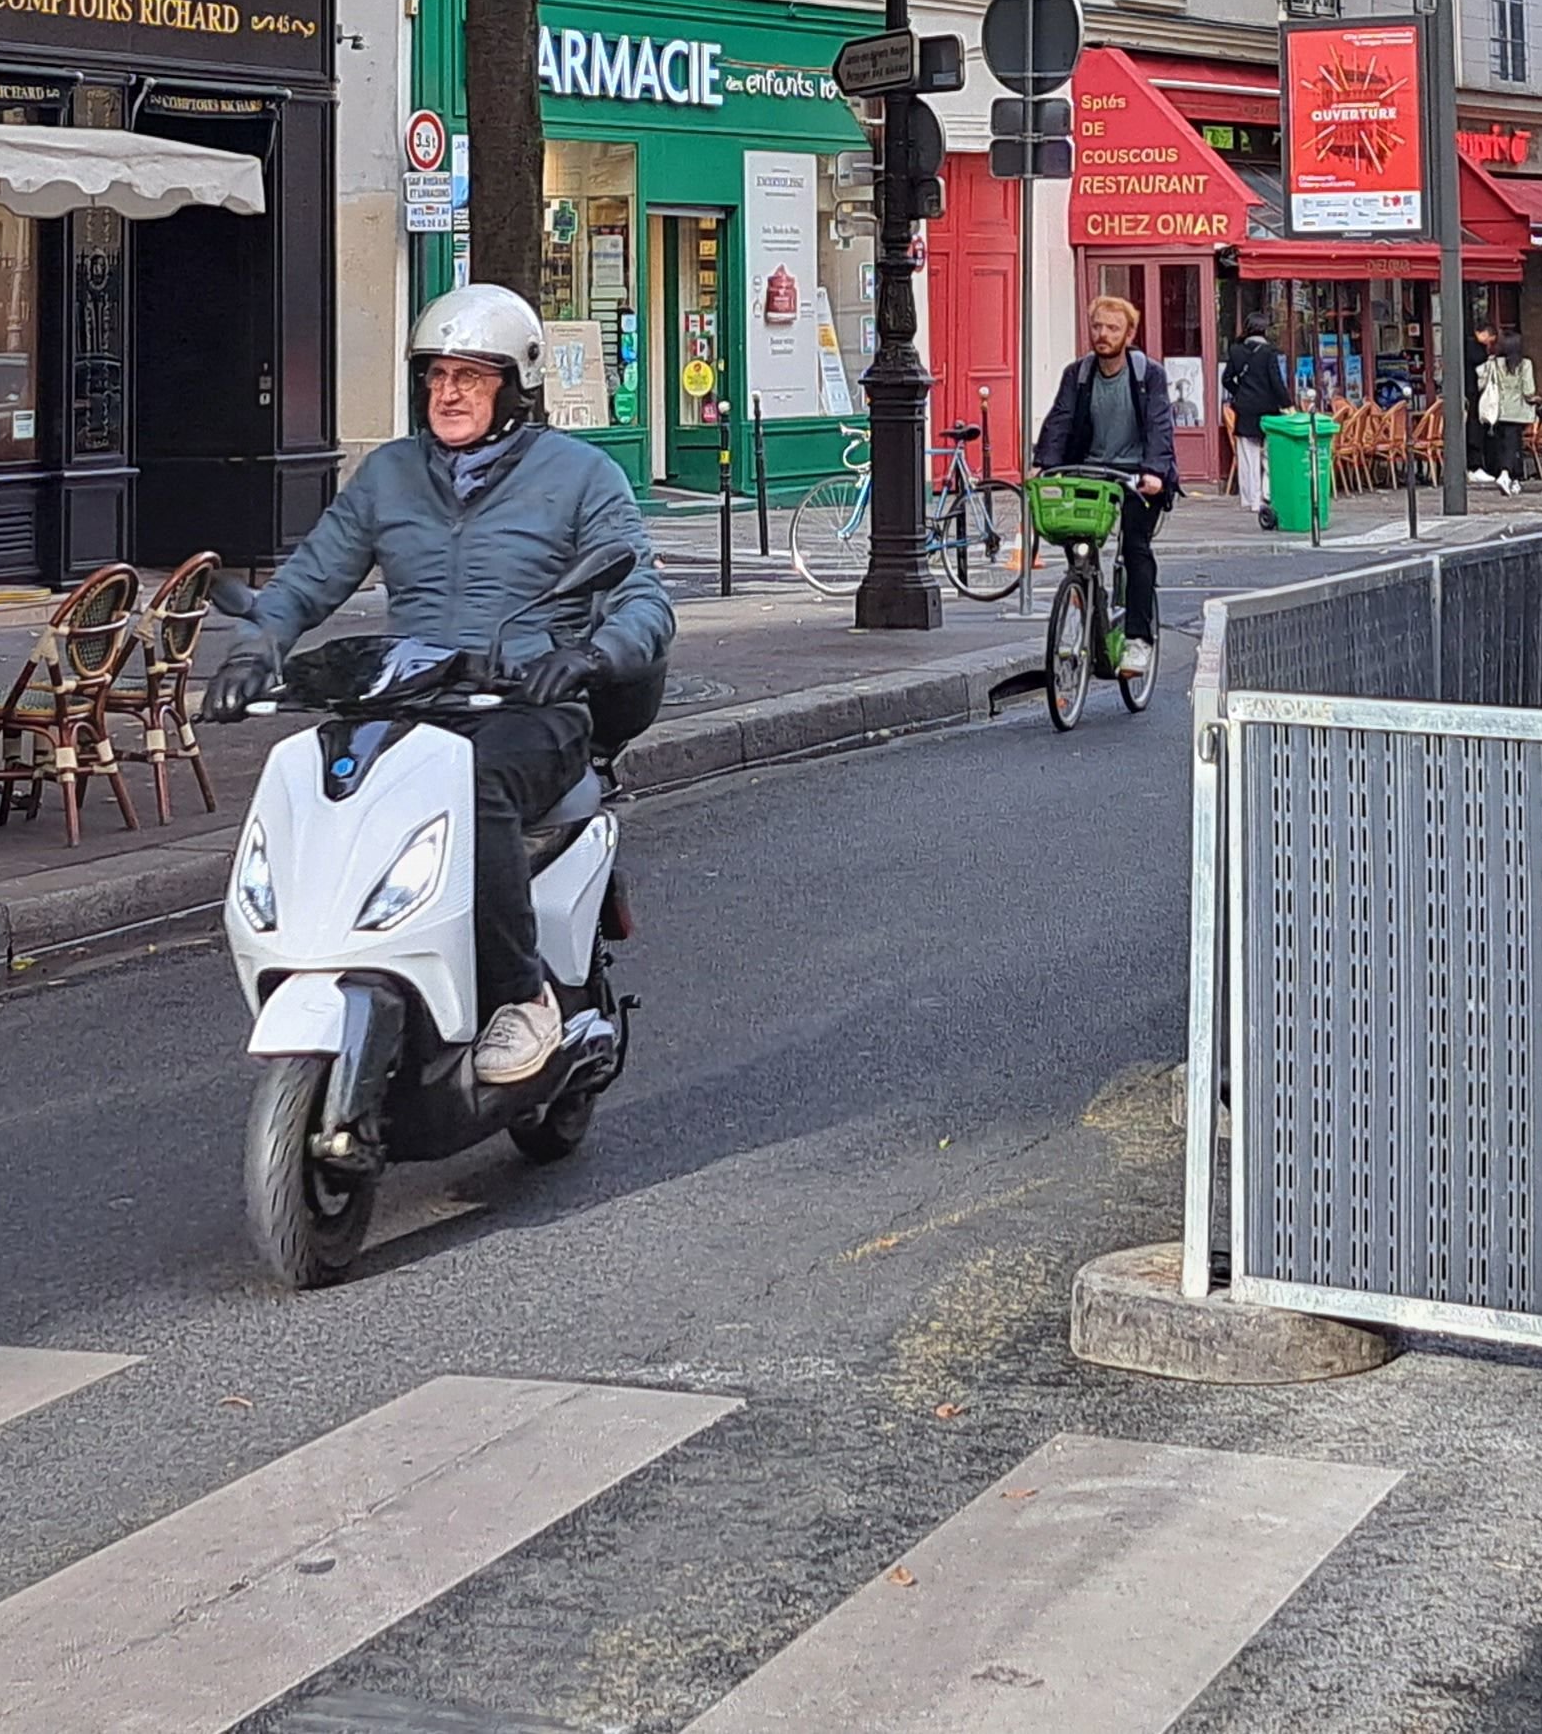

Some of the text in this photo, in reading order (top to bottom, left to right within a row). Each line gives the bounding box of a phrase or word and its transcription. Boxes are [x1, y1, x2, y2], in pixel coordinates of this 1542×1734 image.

[745, 69, 815, 99] enfants
[1311, 107, 1397, 122] OUVERTURE
[1081, 121, 1105, 136] DE
[1081, 147, 1179, 164] COUSCOUS
[1079, 174, 1209, 195] RESTAURANT
[1087, 213, 1229, 236] CHEZ OMAR
